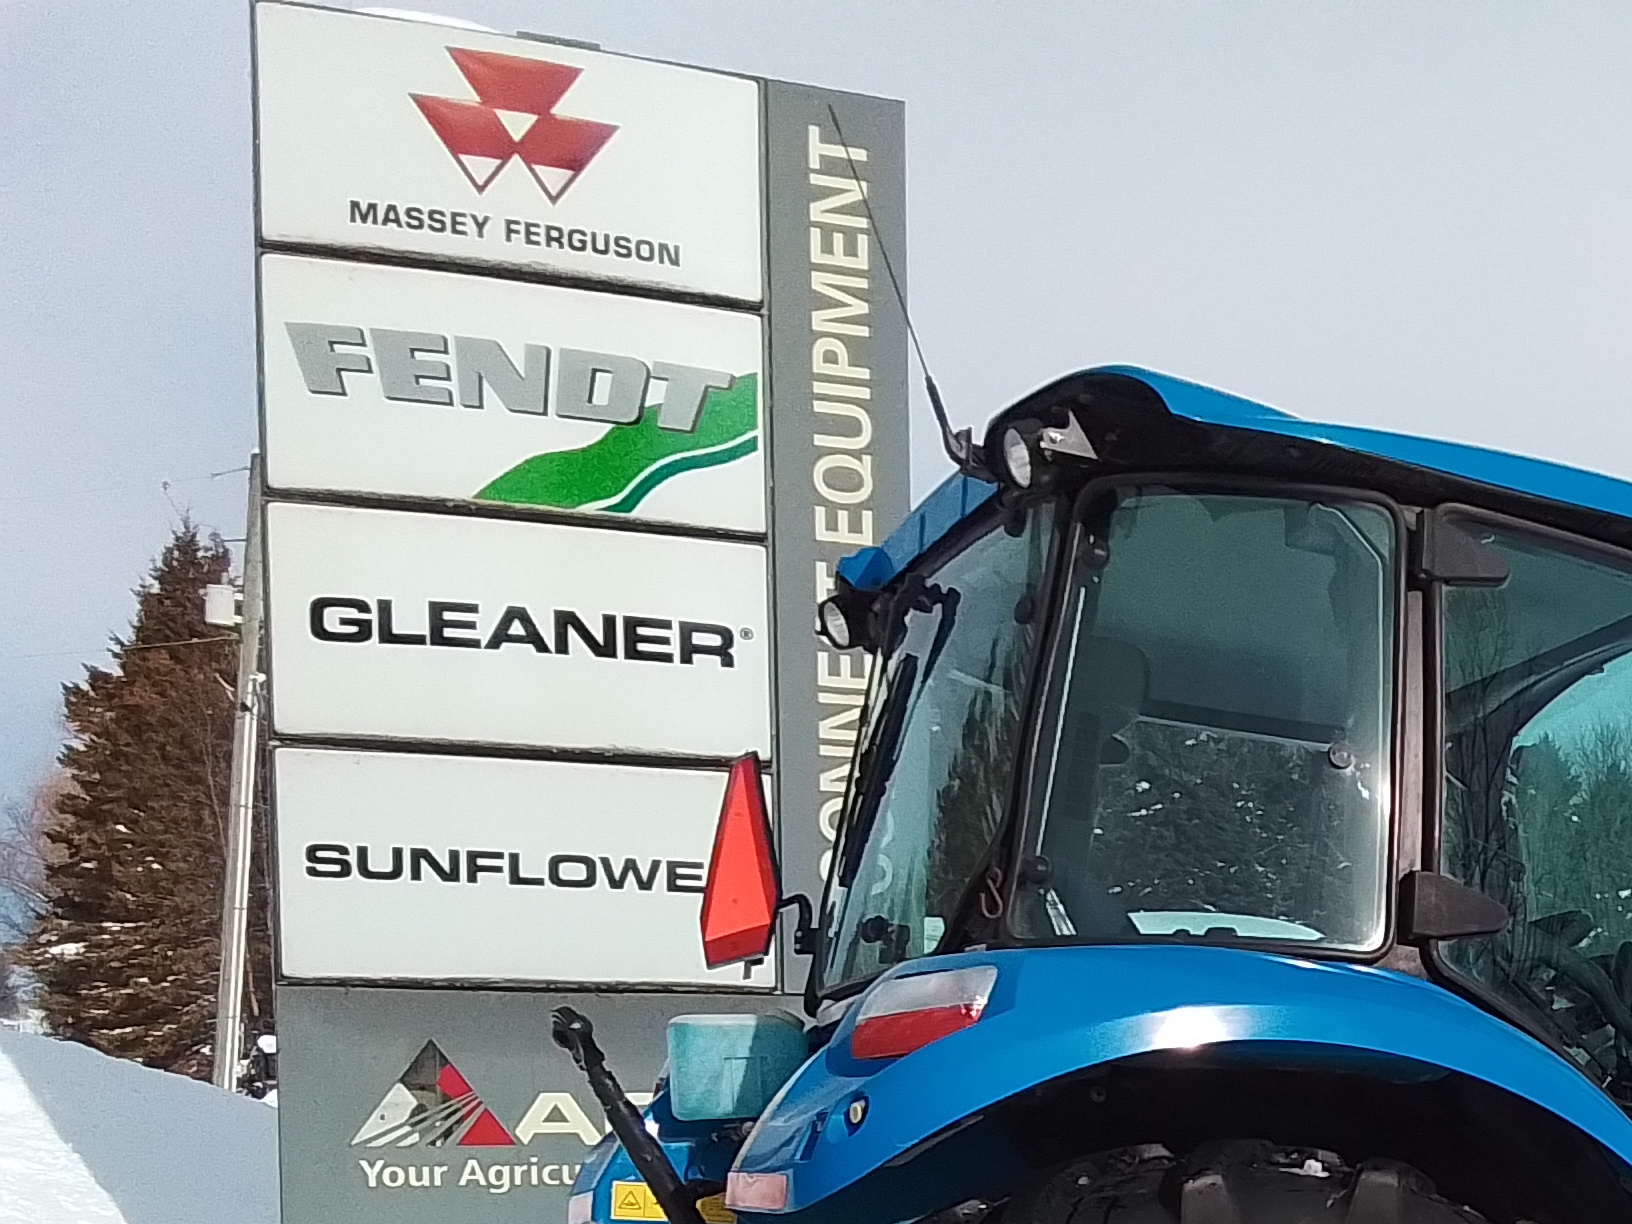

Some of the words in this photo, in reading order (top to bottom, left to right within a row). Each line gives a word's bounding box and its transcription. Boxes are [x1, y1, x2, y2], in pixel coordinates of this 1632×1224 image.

[349, 200, 490, 239] MASSEY
[505, 218, 681, 267] FERGUSON
[284, 321, 737, 434] FENDT
[808, 125, 873, 547] EQUIPMENT
[359, 1159, 449, 1188] Your
